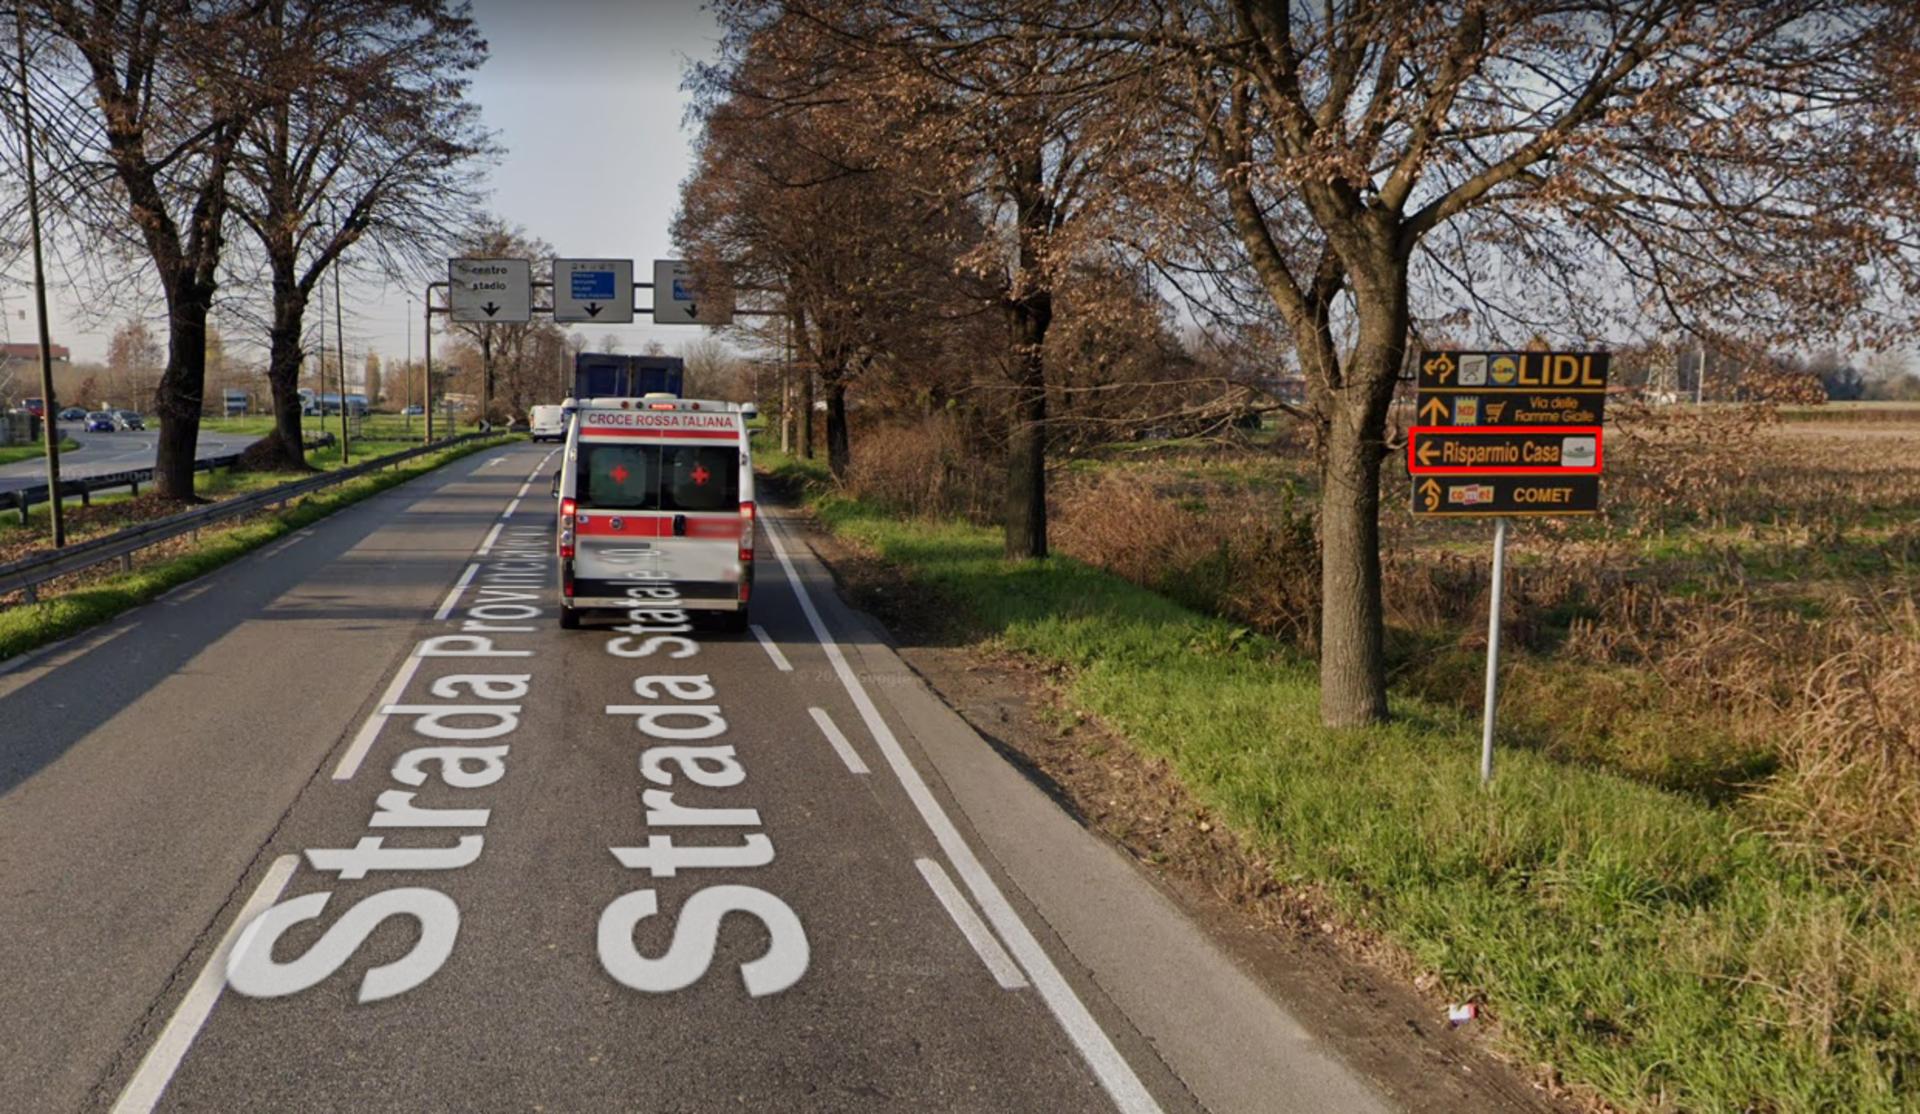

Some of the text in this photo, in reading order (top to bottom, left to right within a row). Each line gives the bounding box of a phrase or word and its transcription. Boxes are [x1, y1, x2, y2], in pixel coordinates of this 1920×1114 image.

[473, 281, 506, 290] stadio
[1518, 355, 1603, 385] LIDL
[588, 413, 632, 425] CROCE
[636, 415, 679, 426] ROSSA
[1442, 441, 1560, 467] Risparmio Casa
[1513, 488, 1573, 503] COMET
